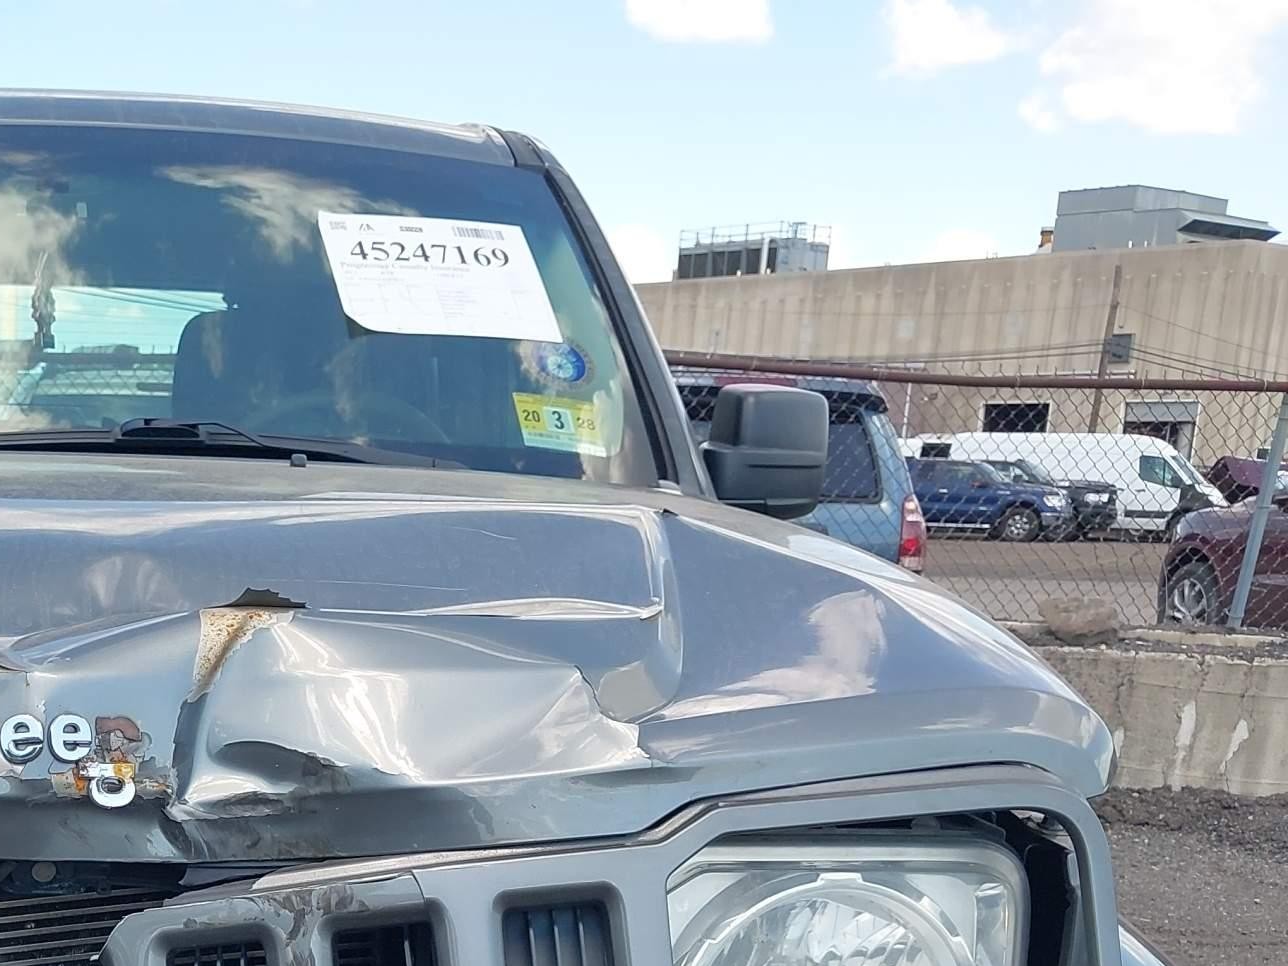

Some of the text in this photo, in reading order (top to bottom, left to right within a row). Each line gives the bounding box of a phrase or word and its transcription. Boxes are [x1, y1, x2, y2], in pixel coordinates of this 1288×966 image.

[350, 240, 510, 268] 45247169
[522, 408, 541, 424] 20
[551, 410, 566, 431] 3
